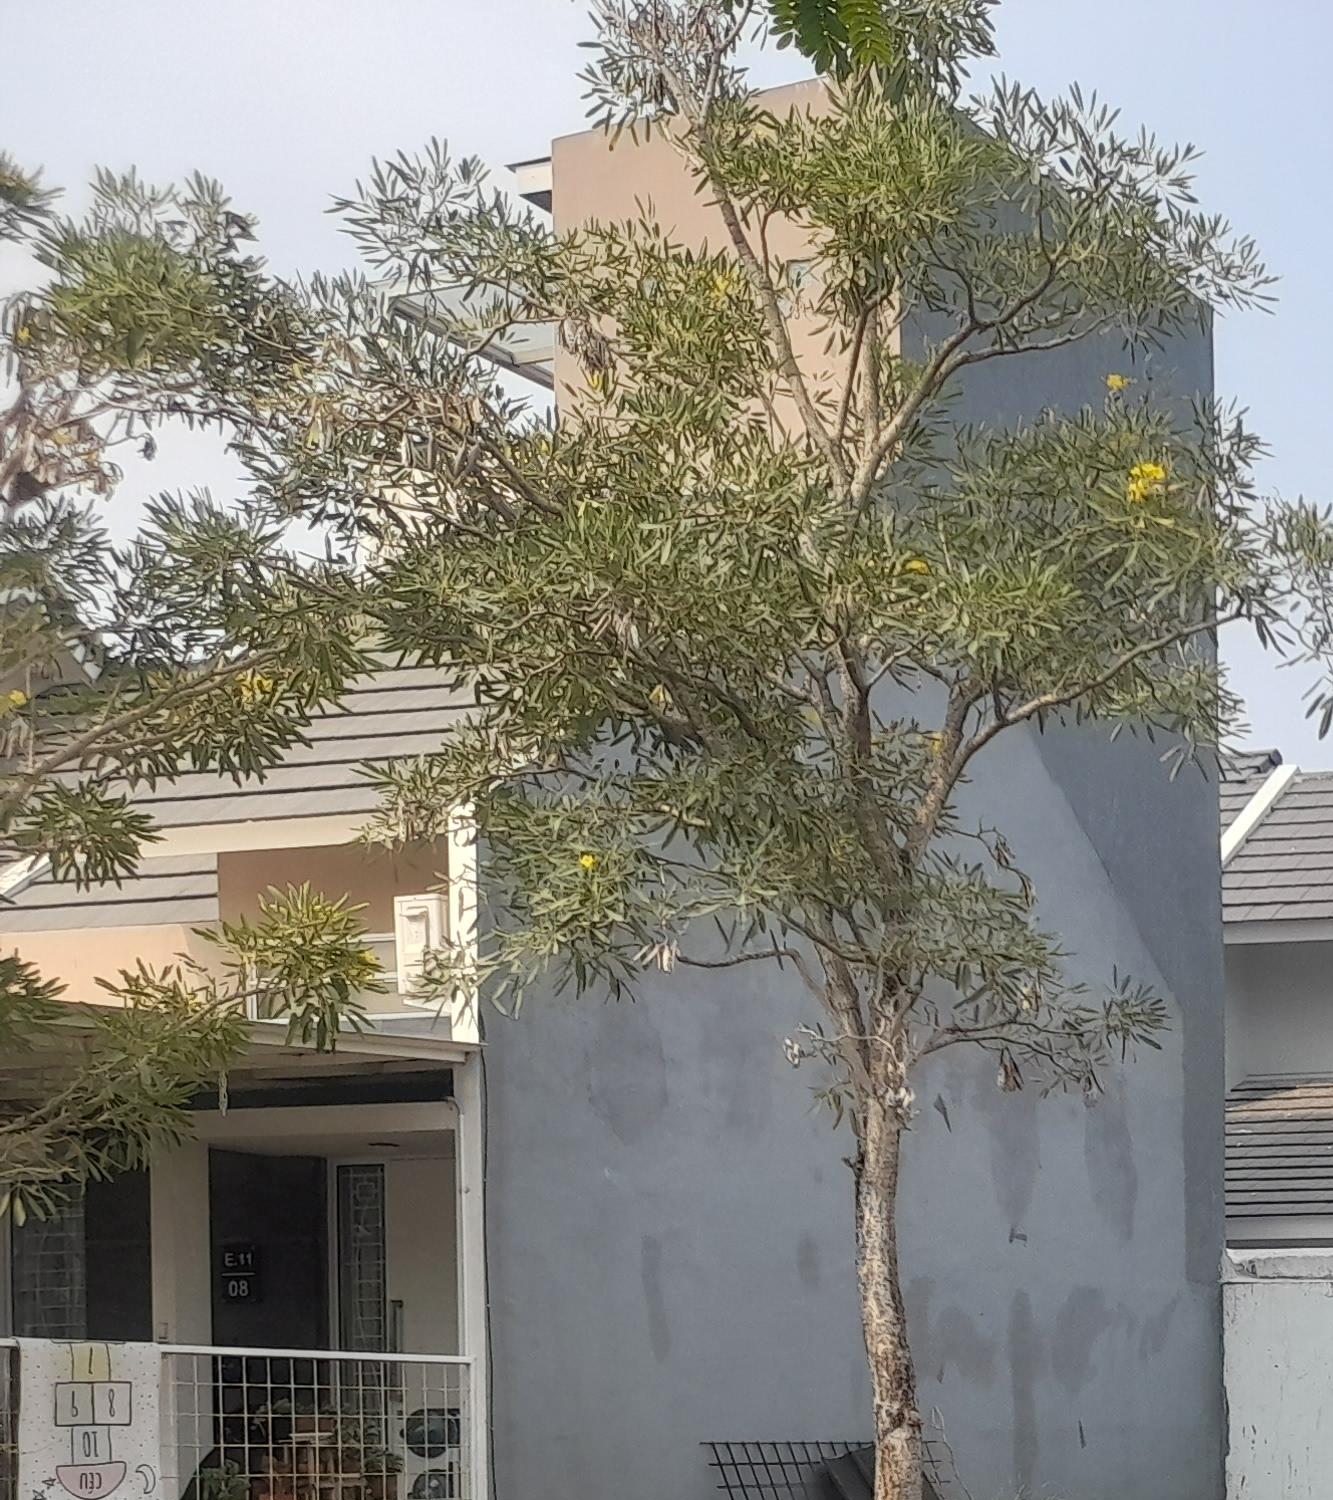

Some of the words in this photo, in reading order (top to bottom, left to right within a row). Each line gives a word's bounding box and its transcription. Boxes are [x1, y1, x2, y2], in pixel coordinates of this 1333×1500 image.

[228, 1280, 249, 1297] 08
[107, 1387, 116, 1418] 8
[82, 1431, 100, 1458] 10
